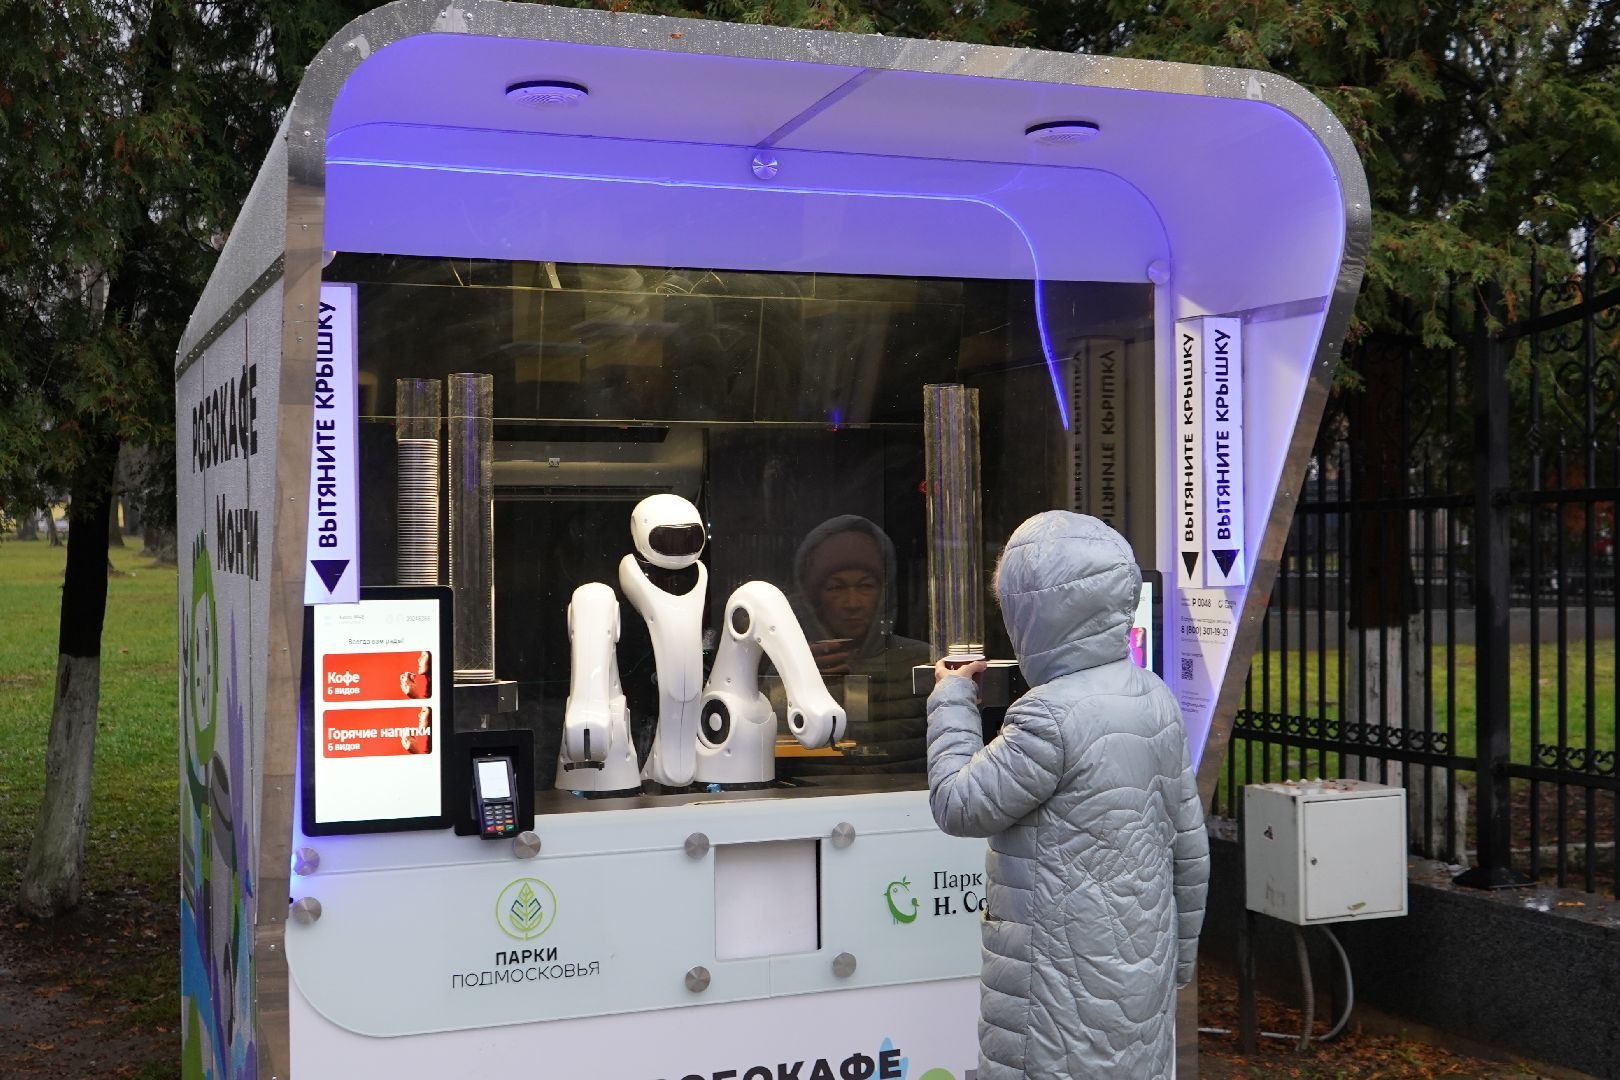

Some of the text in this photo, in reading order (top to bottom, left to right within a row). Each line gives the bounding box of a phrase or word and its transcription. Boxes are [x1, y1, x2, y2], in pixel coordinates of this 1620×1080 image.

[192, 363, 258, 474] РОБОКАФЕ
[315, 301, 338, 548] ВЫТЯНИТЕ КРЫШКУ
[1183, 333, 1195, 542] ВЫТЯНИТЕ КРЫШКУ
[1215, 329, 1231, 540] ВЫТЯНИТЕ КРЫШКУ
[327, 671, 360, 686] Кофе
[327, 686, 361, 696] 6 видов
[328, 726, 431, 743] Горячие напитки
[327, 743, 361, 752] 6 видов
[933, 871, 983, 892] Парк
[933, 896, 957, 916] Н.
[495, 946, 558, 966] ПАРКИ
[452, 961, 600, 989] ПОДМОСКОВЬЯ
